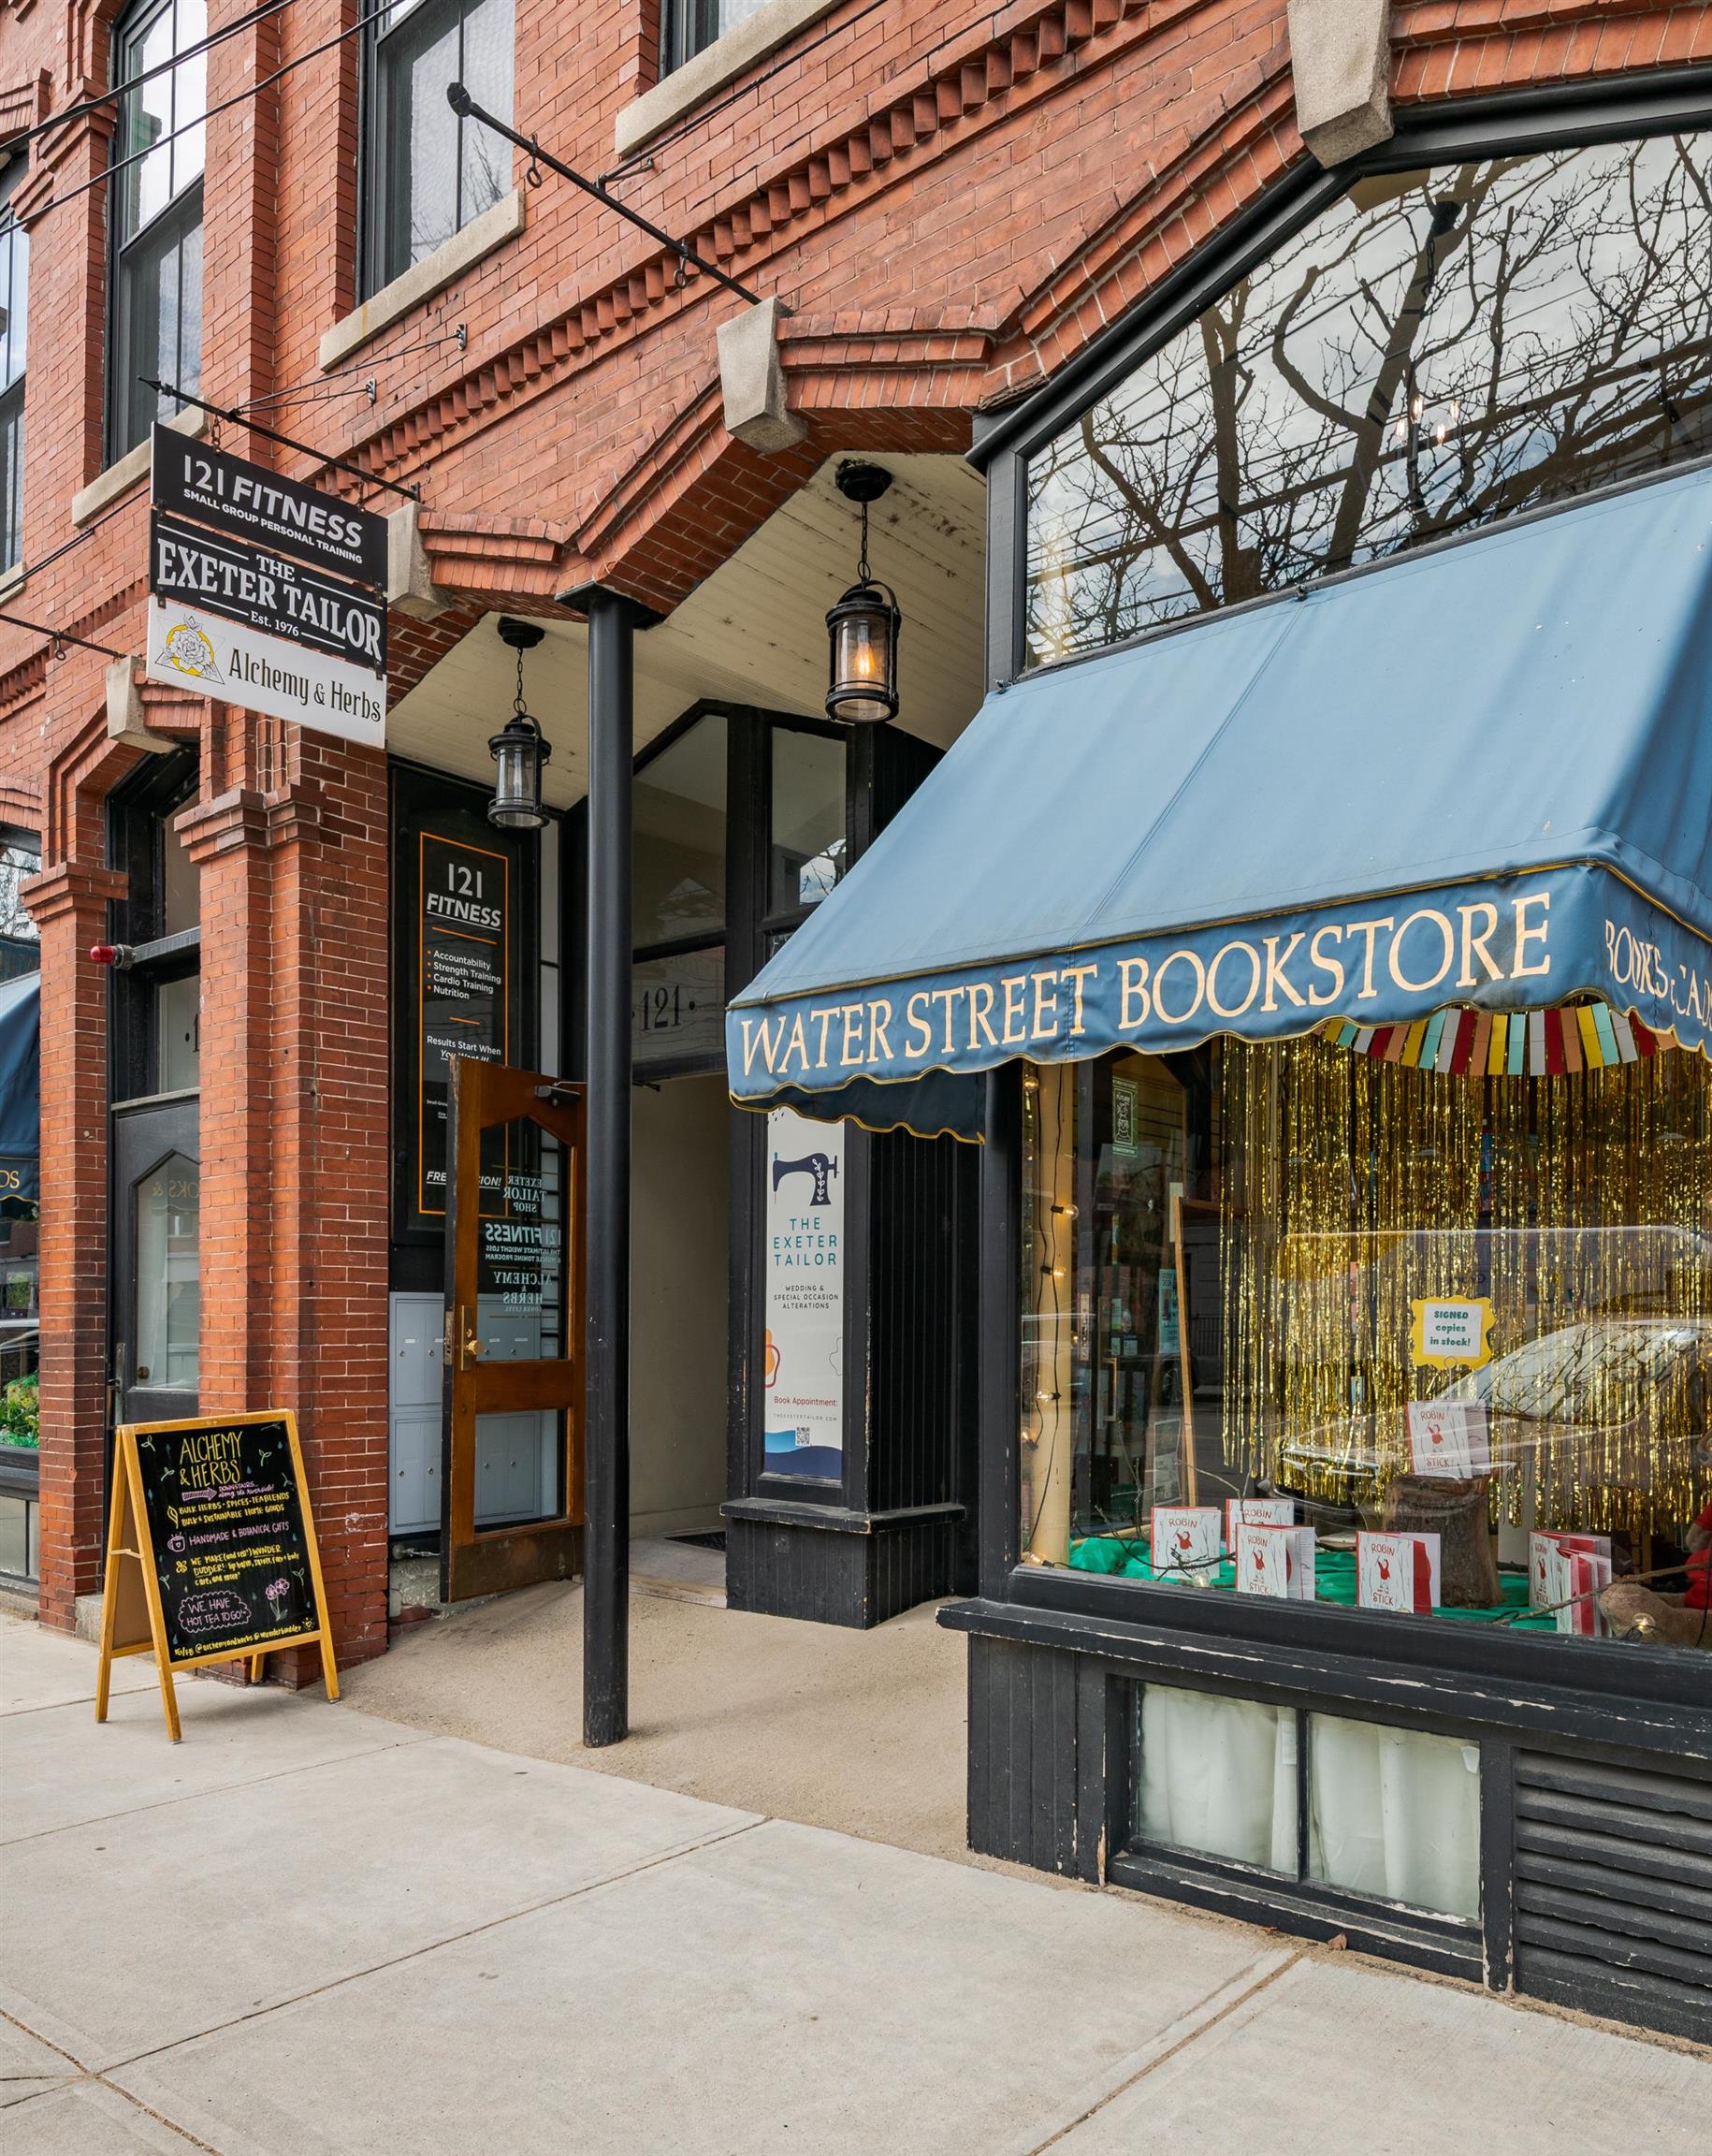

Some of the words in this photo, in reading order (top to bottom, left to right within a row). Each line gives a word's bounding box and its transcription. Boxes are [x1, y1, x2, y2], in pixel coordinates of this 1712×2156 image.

[184, 455, 224, 496] 121
[233, 475, 363, 547] FITNESS
[183, 488, 220, 510] SMALL
[222, 503, 259, 523] GROUP
[261, 517, 314, 546] PERSONAL
[316, 539, 363, 564] TRAINING
[255, 553, 295, 583] THE
[157, 538, 278, 609] EXETER
[283, 584, 382, 663] TAILOR
[251, 610, 271, 628] Est.
[275, 619, 299, 637] 1976
[228, 648, 310, 707] Alchemy
[313, 683, 326, 706] &
[330, 680, 382, 722] Herbs
[448, 863, 482, 898] 121
[427, 893, 501, 928] FITNESS
[434, 950, 491, 971] Accountability
[433, 961, 468, 977] Strength
[471, 969, 501, 984] Training
[433, 973, 460, 986] Cardio
[462, 979, 494, 995] Training
[433, 984, 470, 999] Nutrition
[740, 998, 894, 1077] WATER
[905, 963, 1098, 1058] STREET
[1117, 891, 1551, 1030] BOOKSTORE
[642, 984, 682, 1031] 121
[427, 1035, 456, 1048] Results
[457, 1041, 477, 1052] Start
[479, 1043, 501, 1056] When
[427, 1171, 447, 1182] FRE
[790, 1217, 820, 1231] THE
[774, 1234, 837, 1249] EXETER
[774, 1252, 837, 1266] TAILOR
[1434, 1310, 1469, 1319] SIGNED
[1435, 1324, 1466, 1334] copies
[1430, 1336, 1440, 1346] in
[1441, 1337, 1471, 1347] stock!
[774, 1395, 790, 1404] Book
[1420, 1410, 1444, 1420] ROBIN
[179, 1431, 243, 1465] ALCHEMY
[1427, 1457, 1450, 1467] STICK
[180, 1468, 190, 1486] &
[191, 1460, 240, 1489] HERBS
[179, 1506, 196, 1515] BULK
[198, 1501, 222, 1511] HERBS
[226, 1497, 249, 1508] SPICES
[265, 1504, 284, 1513] GOODS
[1244, 1508, 1272, 1519] ROBIN
[1168, 1518, 1197, 1528] ROBIN
[189, 1531, 230, 1546] HANDMADE
[238, 1522, 270, 1537] BOTANICAL
[272, 1521, 290, 1533] GIFTS
[1247, 1535, 1269, 1548] ROBIN
[1371, 1543, 1395, 1556] ROBIN
[191, 1557, 201, 1566] WE
[204, 1553, 224, 1564] MAKE
[1249, 1581, 1269, 1595] STICK
[188, 1600, 207, 1613] WE
[209, 1597, 230, 1610] HAVE
[1372, 1592, 1394, 1606] STICK
[187, 1615, 202, 1626] HOT
[205, 1613, 220, 1624] TEA
